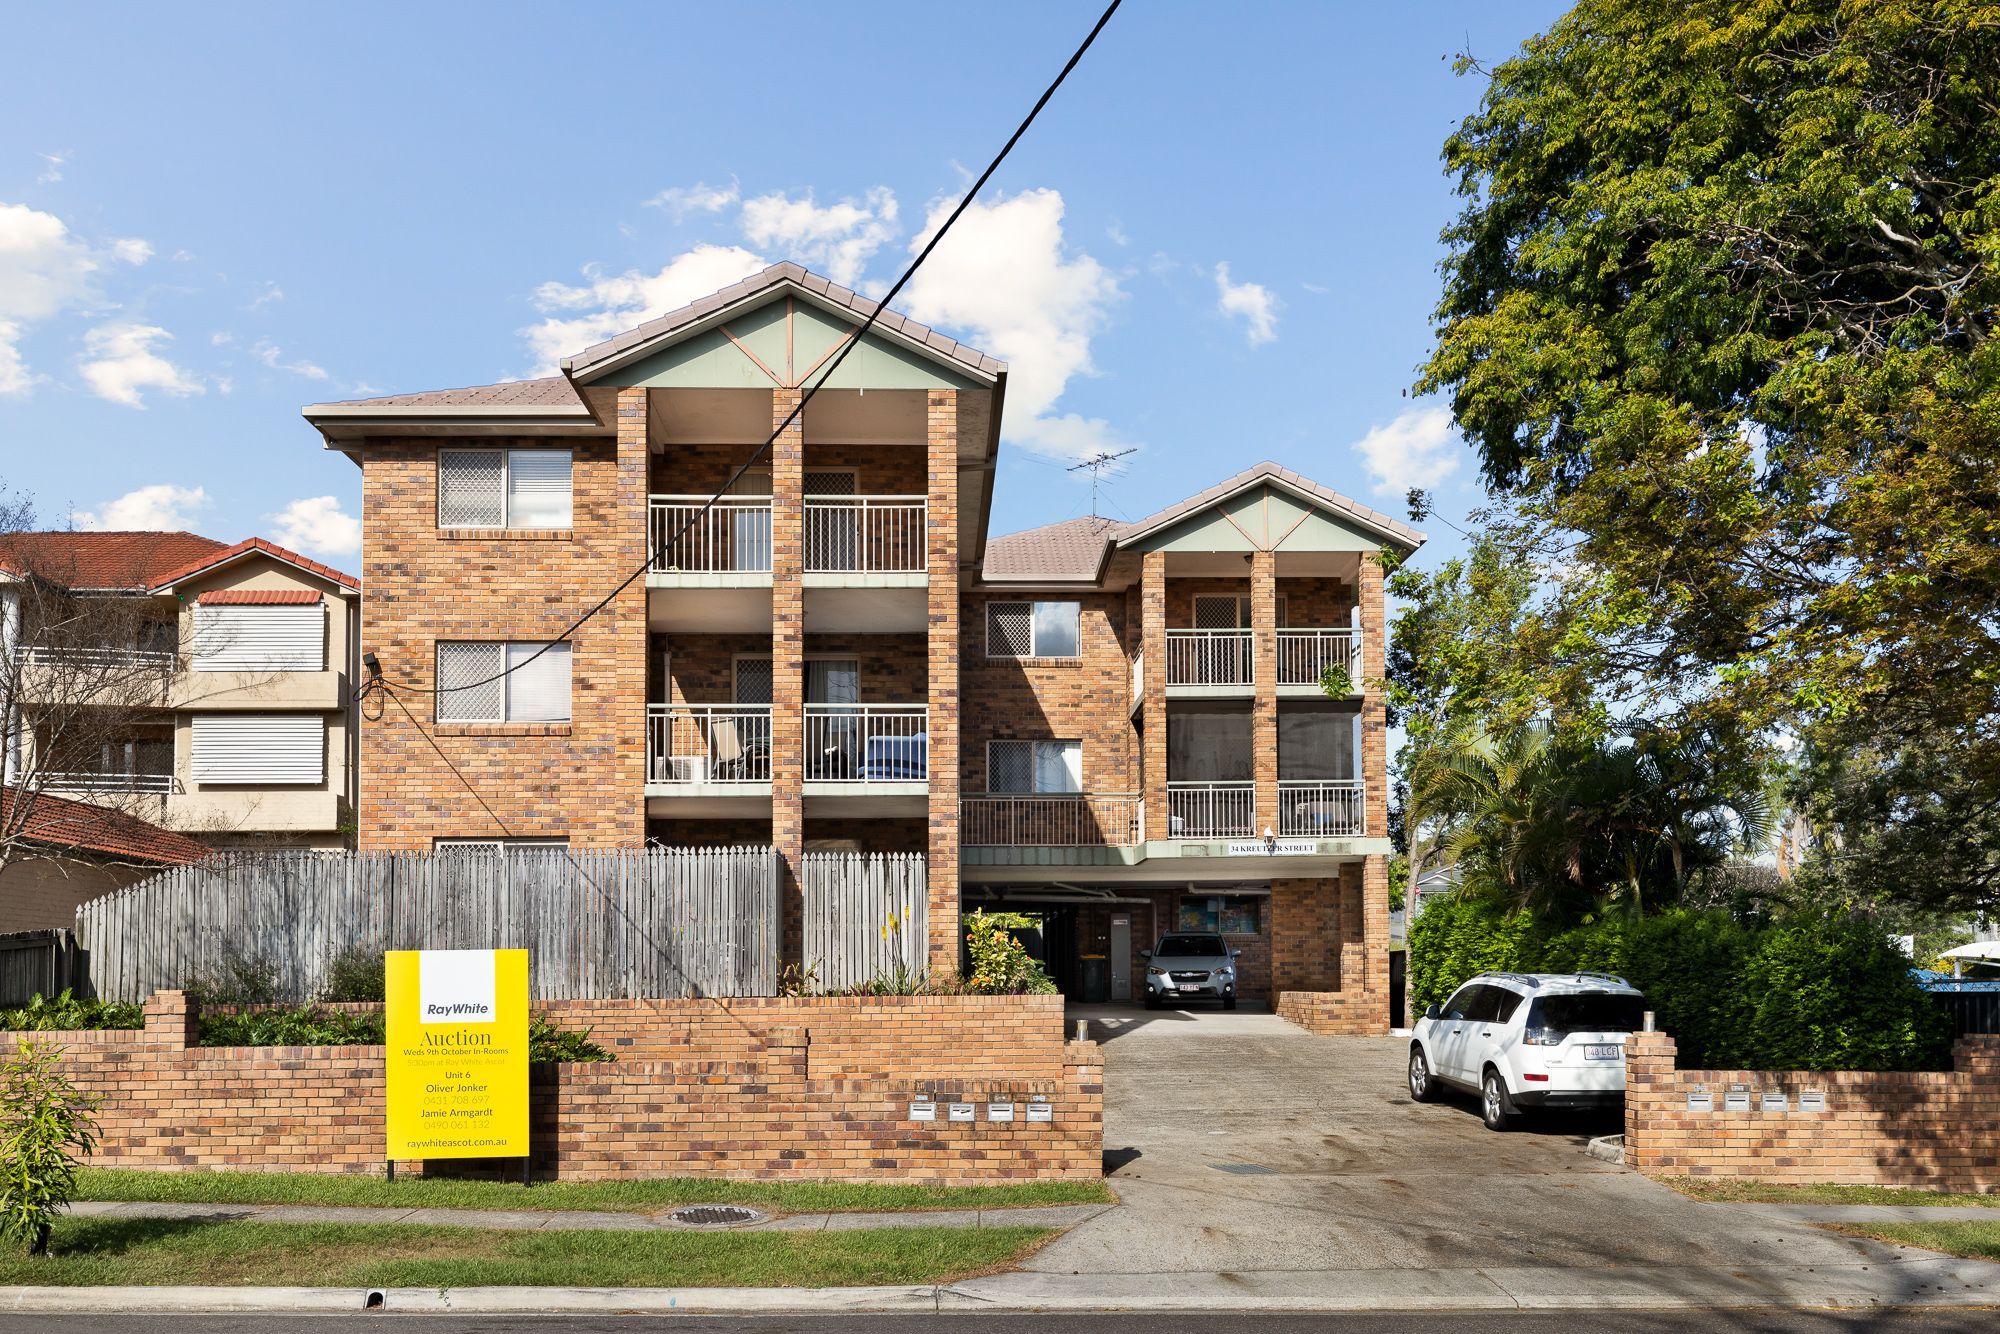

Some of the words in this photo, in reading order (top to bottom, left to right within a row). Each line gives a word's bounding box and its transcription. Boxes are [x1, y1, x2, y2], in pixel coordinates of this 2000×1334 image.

[420, 1030, 491, 1046] Auction
[445, 1058, 459, 1066] Ray
[426, 1084, 454, 1093] Oliver
[457, 1084, 488, 1092] Jonker
[424, 1096, 447, 1105] 0431
[452, 1096, 469, 1105] 708
[472, 1096, 490, 1104] 697
[421, 1109, 447, 1118] Jamie
[449, 1108, 493, 1118] Armgardt
[424, 1121, 449, 1130] 0490
[450, 1120, 468, 1129] 061
[473, 1120, 490, 1129] 132
[407, 1138, 507, 1149] raywhiteascot.com.au
